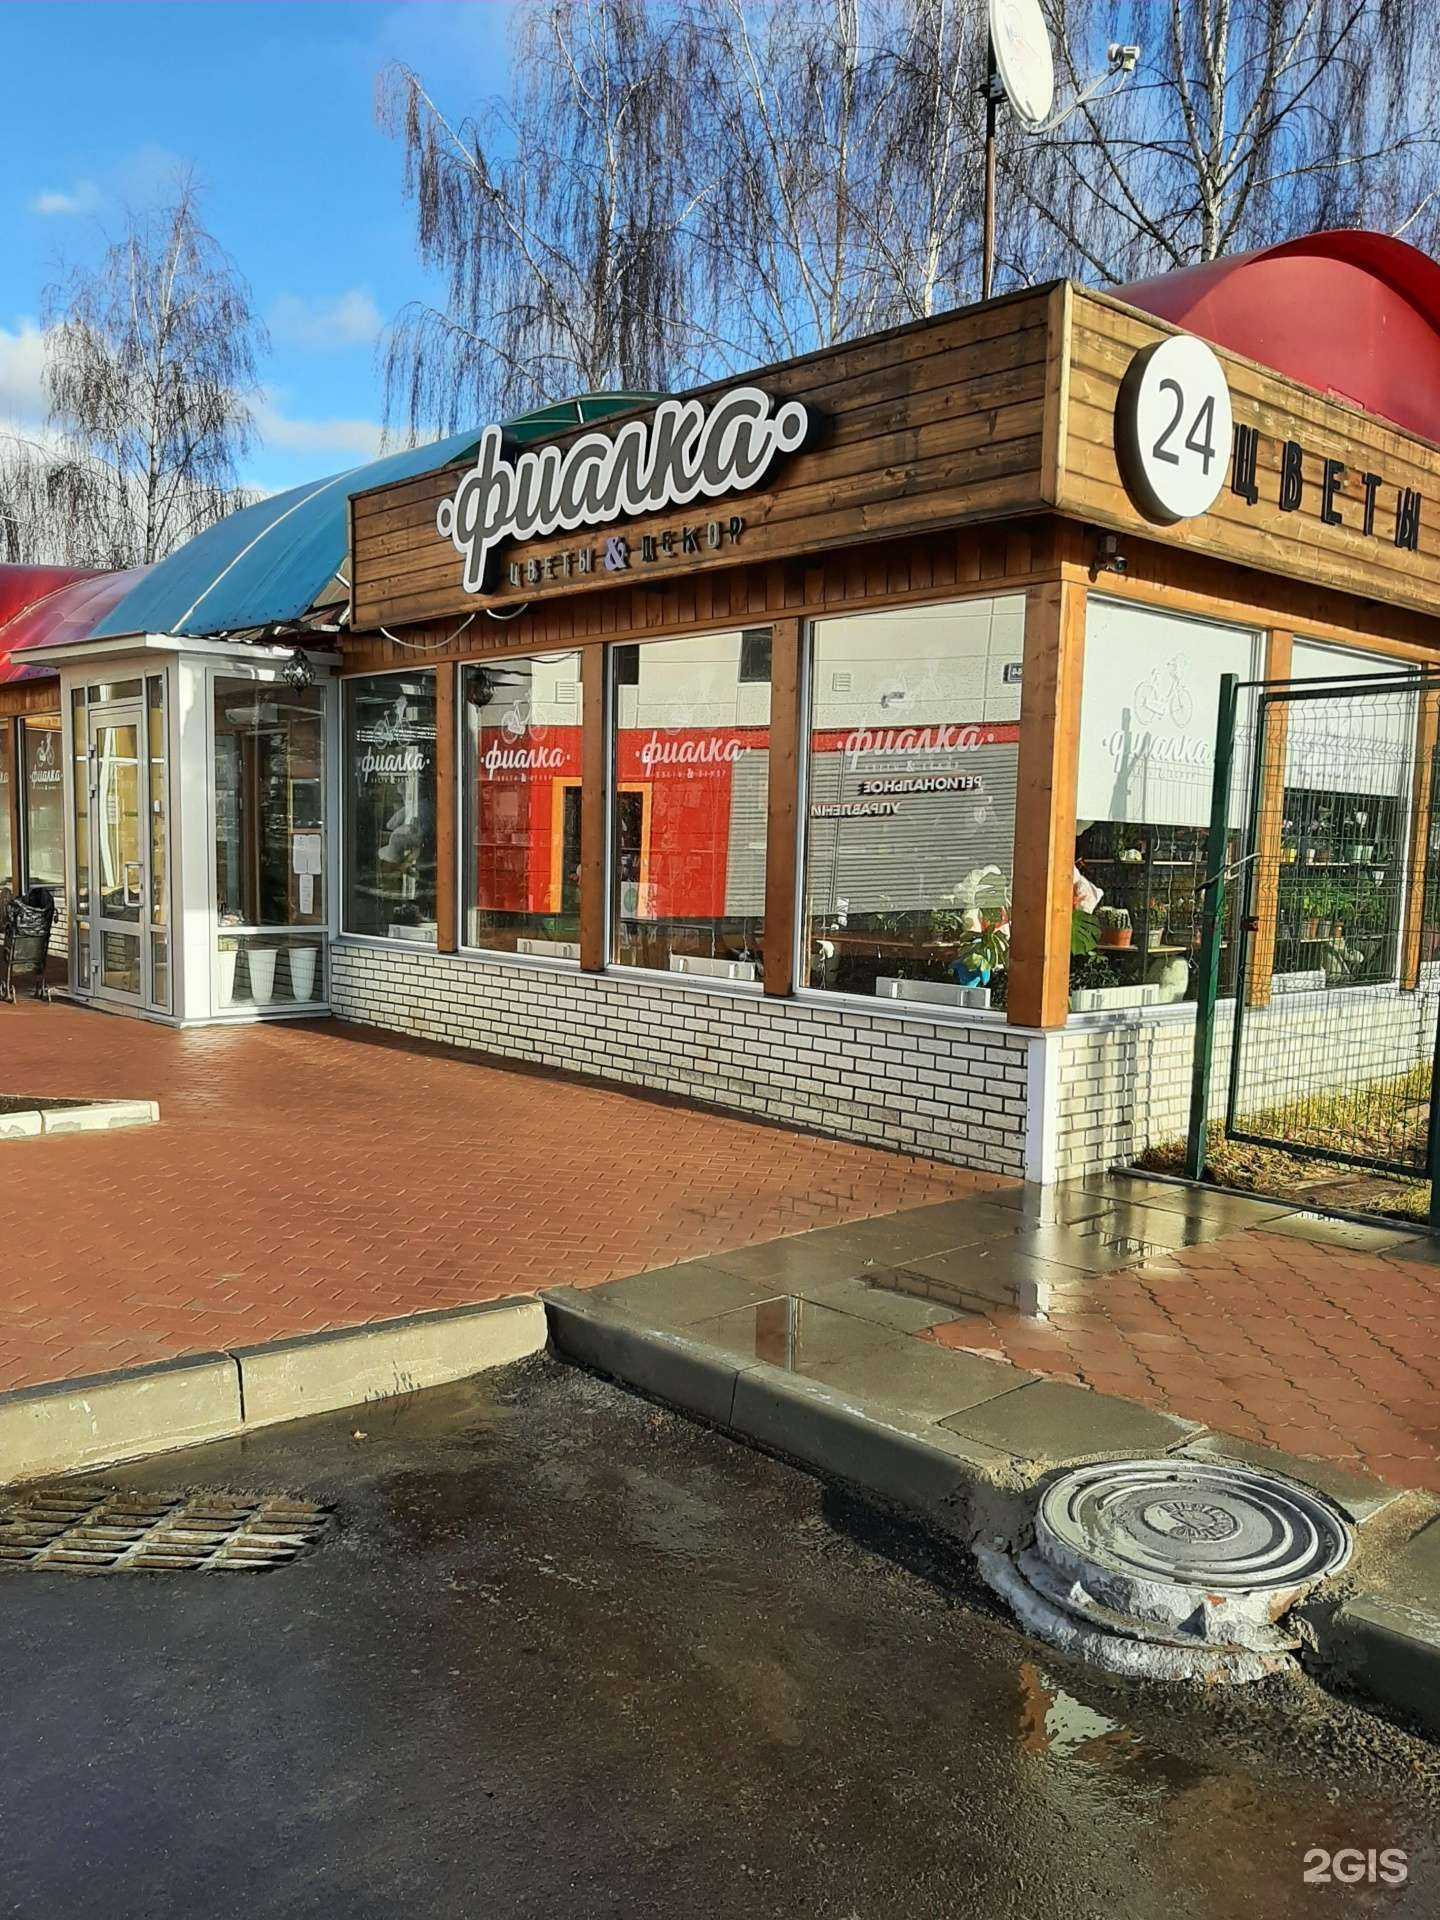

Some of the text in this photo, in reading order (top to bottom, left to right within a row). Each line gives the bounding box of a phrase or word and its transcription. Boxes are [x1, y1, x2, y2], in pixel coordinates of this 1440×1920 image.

[1152, 378, 1216, 476] 24
[509, 516, 744, 588] ЦВЕТЫ & ДЕКОР
[361, 746, 425, 782] фиалка
[485, 740, 566, 780] фиалка
[642, 730, 744, 777] фиалка
